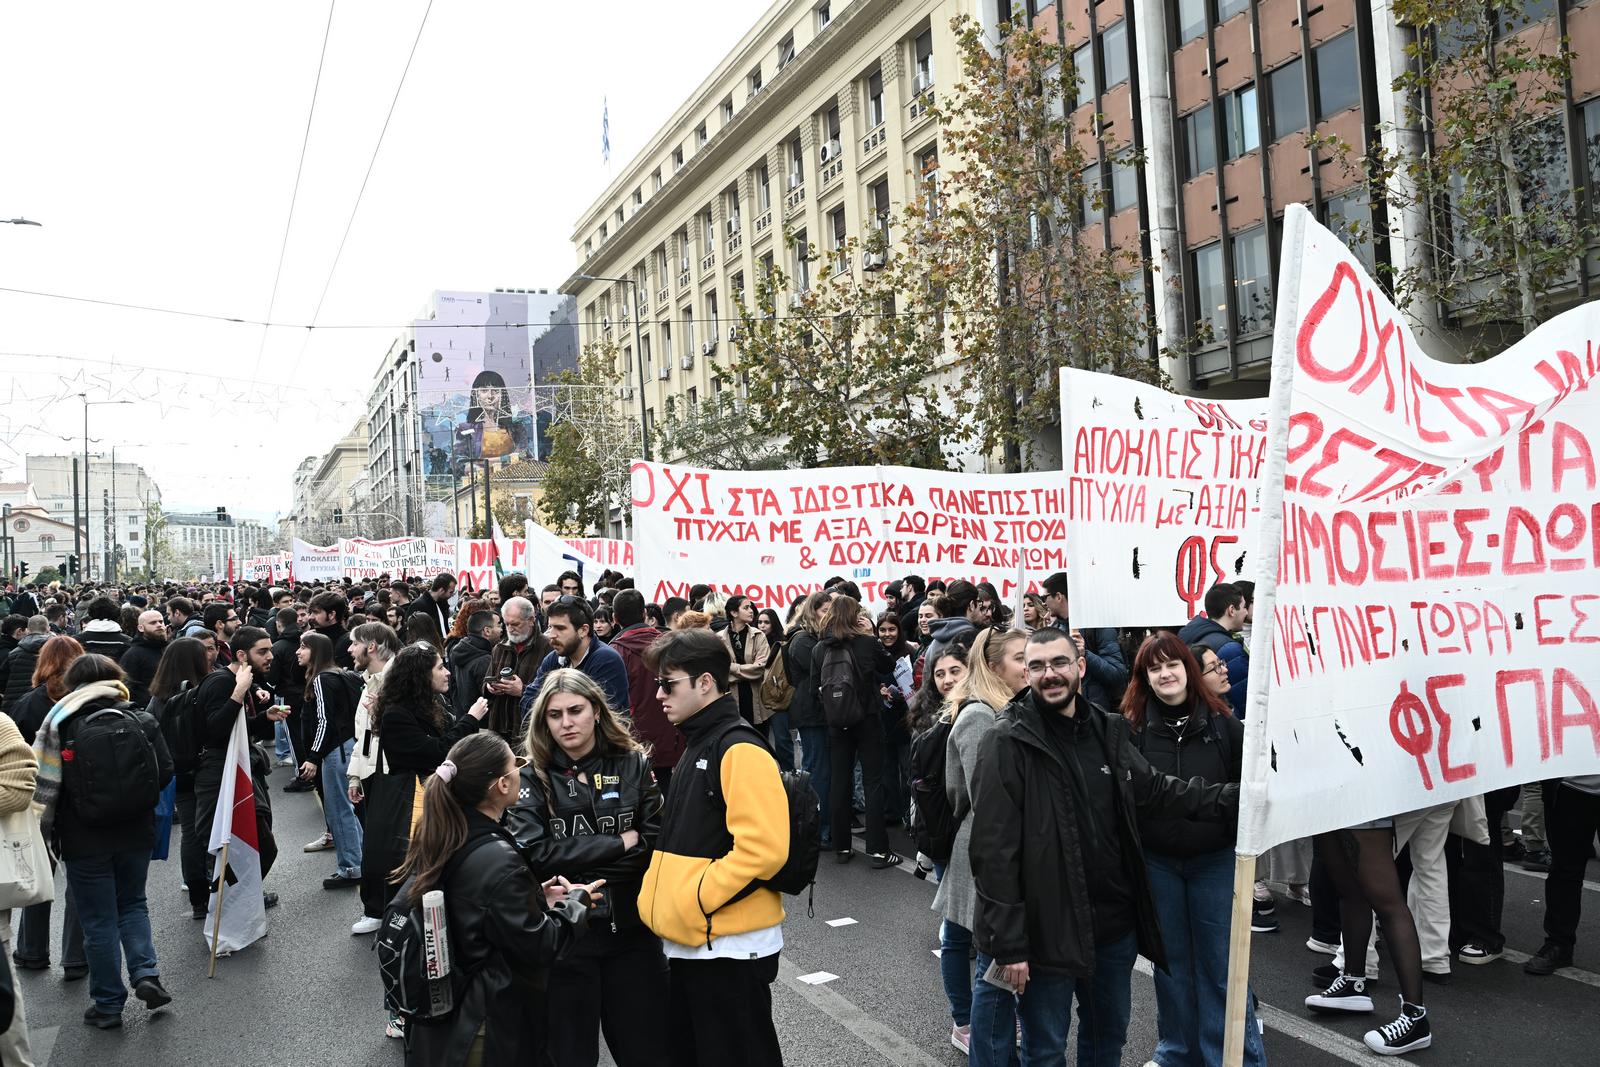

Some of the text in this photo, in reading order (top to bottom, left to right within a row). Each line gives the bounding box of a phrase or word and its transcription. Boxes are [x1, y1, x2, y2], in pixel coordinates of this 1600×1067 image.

[1296, 261, 1410, 426] ΟΧΙ
[1410, 361, 1536, 443] ΣΤΑ
[1184, 399, 1243, 431] ΟΧΙ
[1073, 426, 1266, 479] ΑΠΟΚΛΕΙΣΤΙΚΑ
[630, 462, 1064, 516] ΟΧΙ ΣΤΑ ΙΔΙΩΤΙΚΑ ΠΑΝΕΠΙΣΤΗ
[1069, 476, 1147, 523] ΠΤΥΧΙΑ
[1195, 484, 1246, 530] ΑΞΙΑ
[674, 517, 760, 542] ΠΤΥΧΙΑ
[769, 520, 803, 543] ΜΕ
[814, 517, 872, 542] ΑΞΙΑ
[994, 519, 1065, 543] ΣΠΟΥΔ
[344, 556, 356, 567] ΟΧΙ
[382, 555, 427, 568] ΙΣΟΤΙΜΗΣΗ
[345, 541, 359, 555] ΟΧΙ
[390, 540, 427, 559] ΙΔΙΩΤΙΚΑ
[609, 541, 618, 565] Η
[800, 546, 817, 569] &
[829, 541, 930, 565] ΔΟΥΛΕΙΑ
[936, 543, 967, 563] ΜΕ
[973, 545, 1067, 570] ΔΙΚΑΙΩΜ
[345, 567, 377, 578] ΠΤΥΧΙΑ
[1312, 604, 1397, 674] ΓΙΝΕΙ
[1411, 601, 1512, 656] ΤΩΡΑ
[1389, 667, 1600, 790] ΦΣ ΠΑ
[567, 779, 577, 797] 1
[549, 812, 634, 839] RACE
[426, 929, 441, 1005] ΡΙΖΣΠΑΣΤΗΣ
